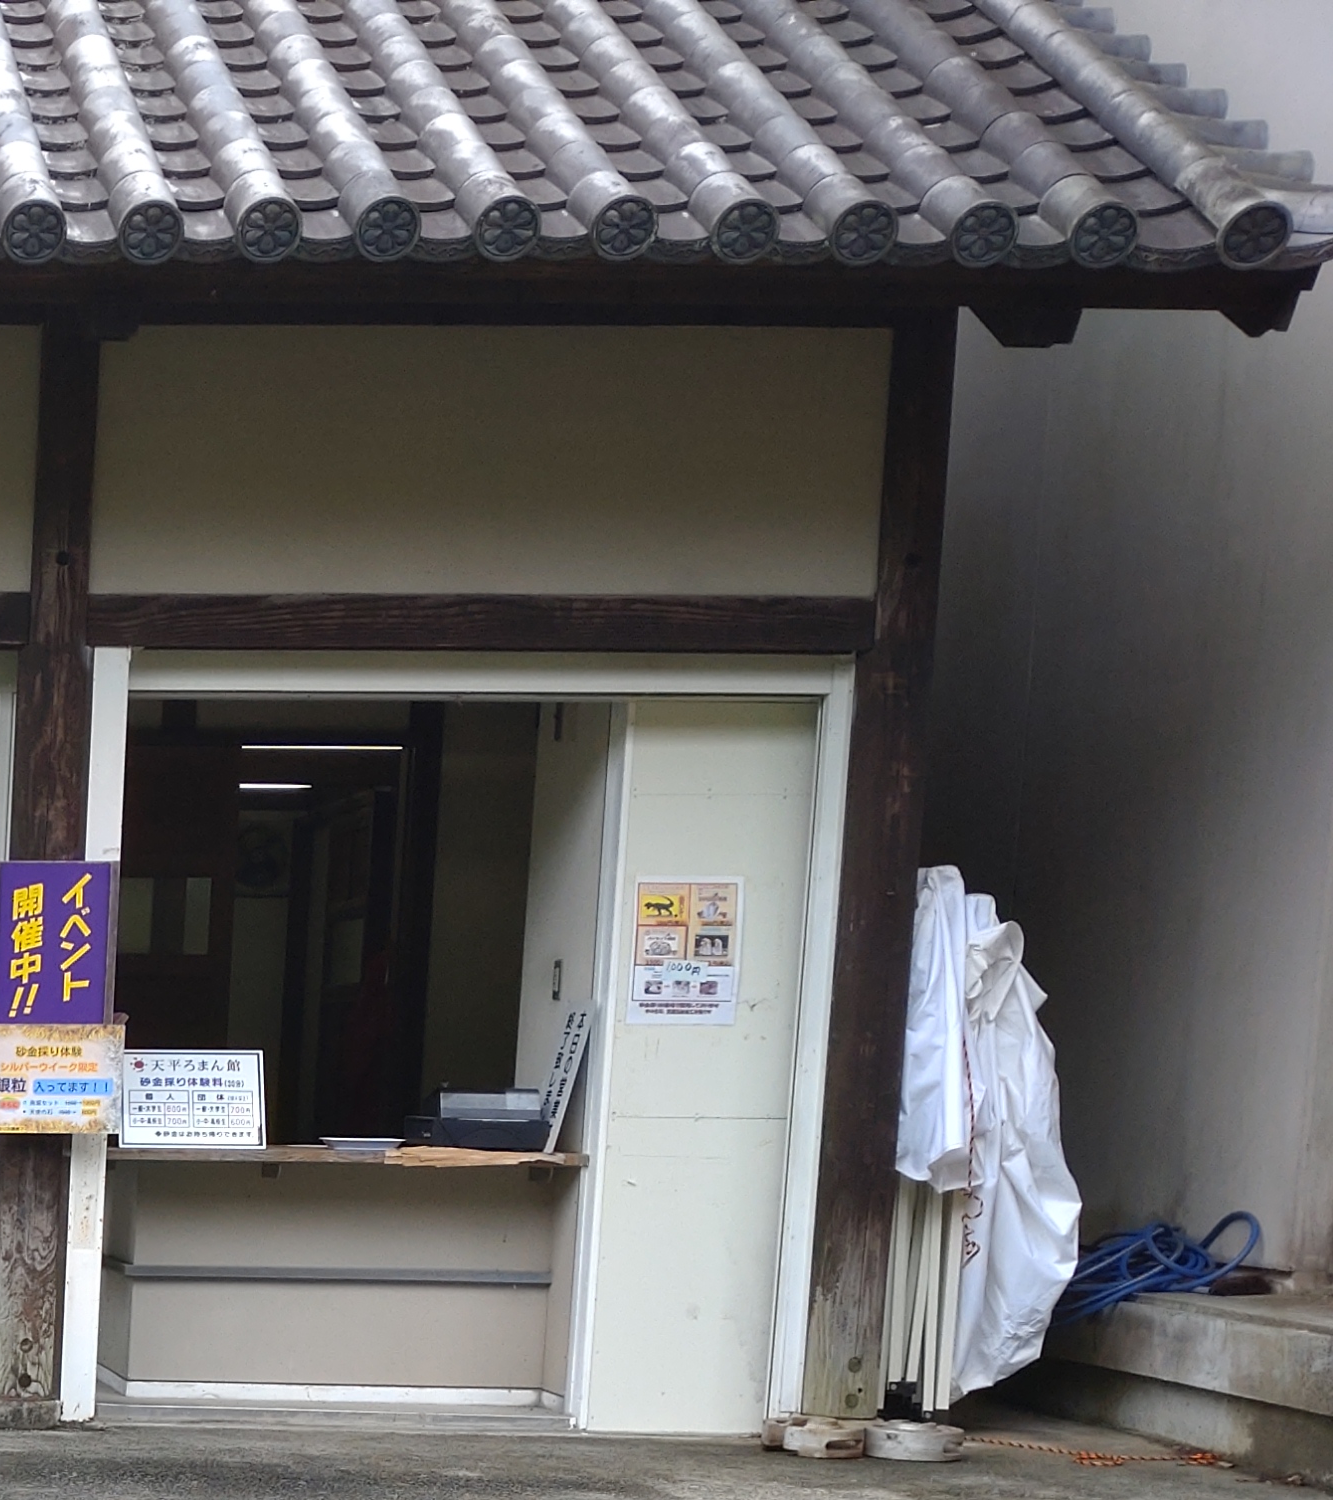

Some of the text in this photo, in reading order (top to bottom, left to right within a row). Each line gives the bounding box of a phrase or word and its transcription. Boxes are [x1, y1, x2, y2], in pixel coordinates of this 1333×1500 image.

[60, 873, 92, 1002] イベント
[15, 1046, 82, 1058] 砂金採り体験
[151, 1059, 241, 1073] 天平ろまん館
